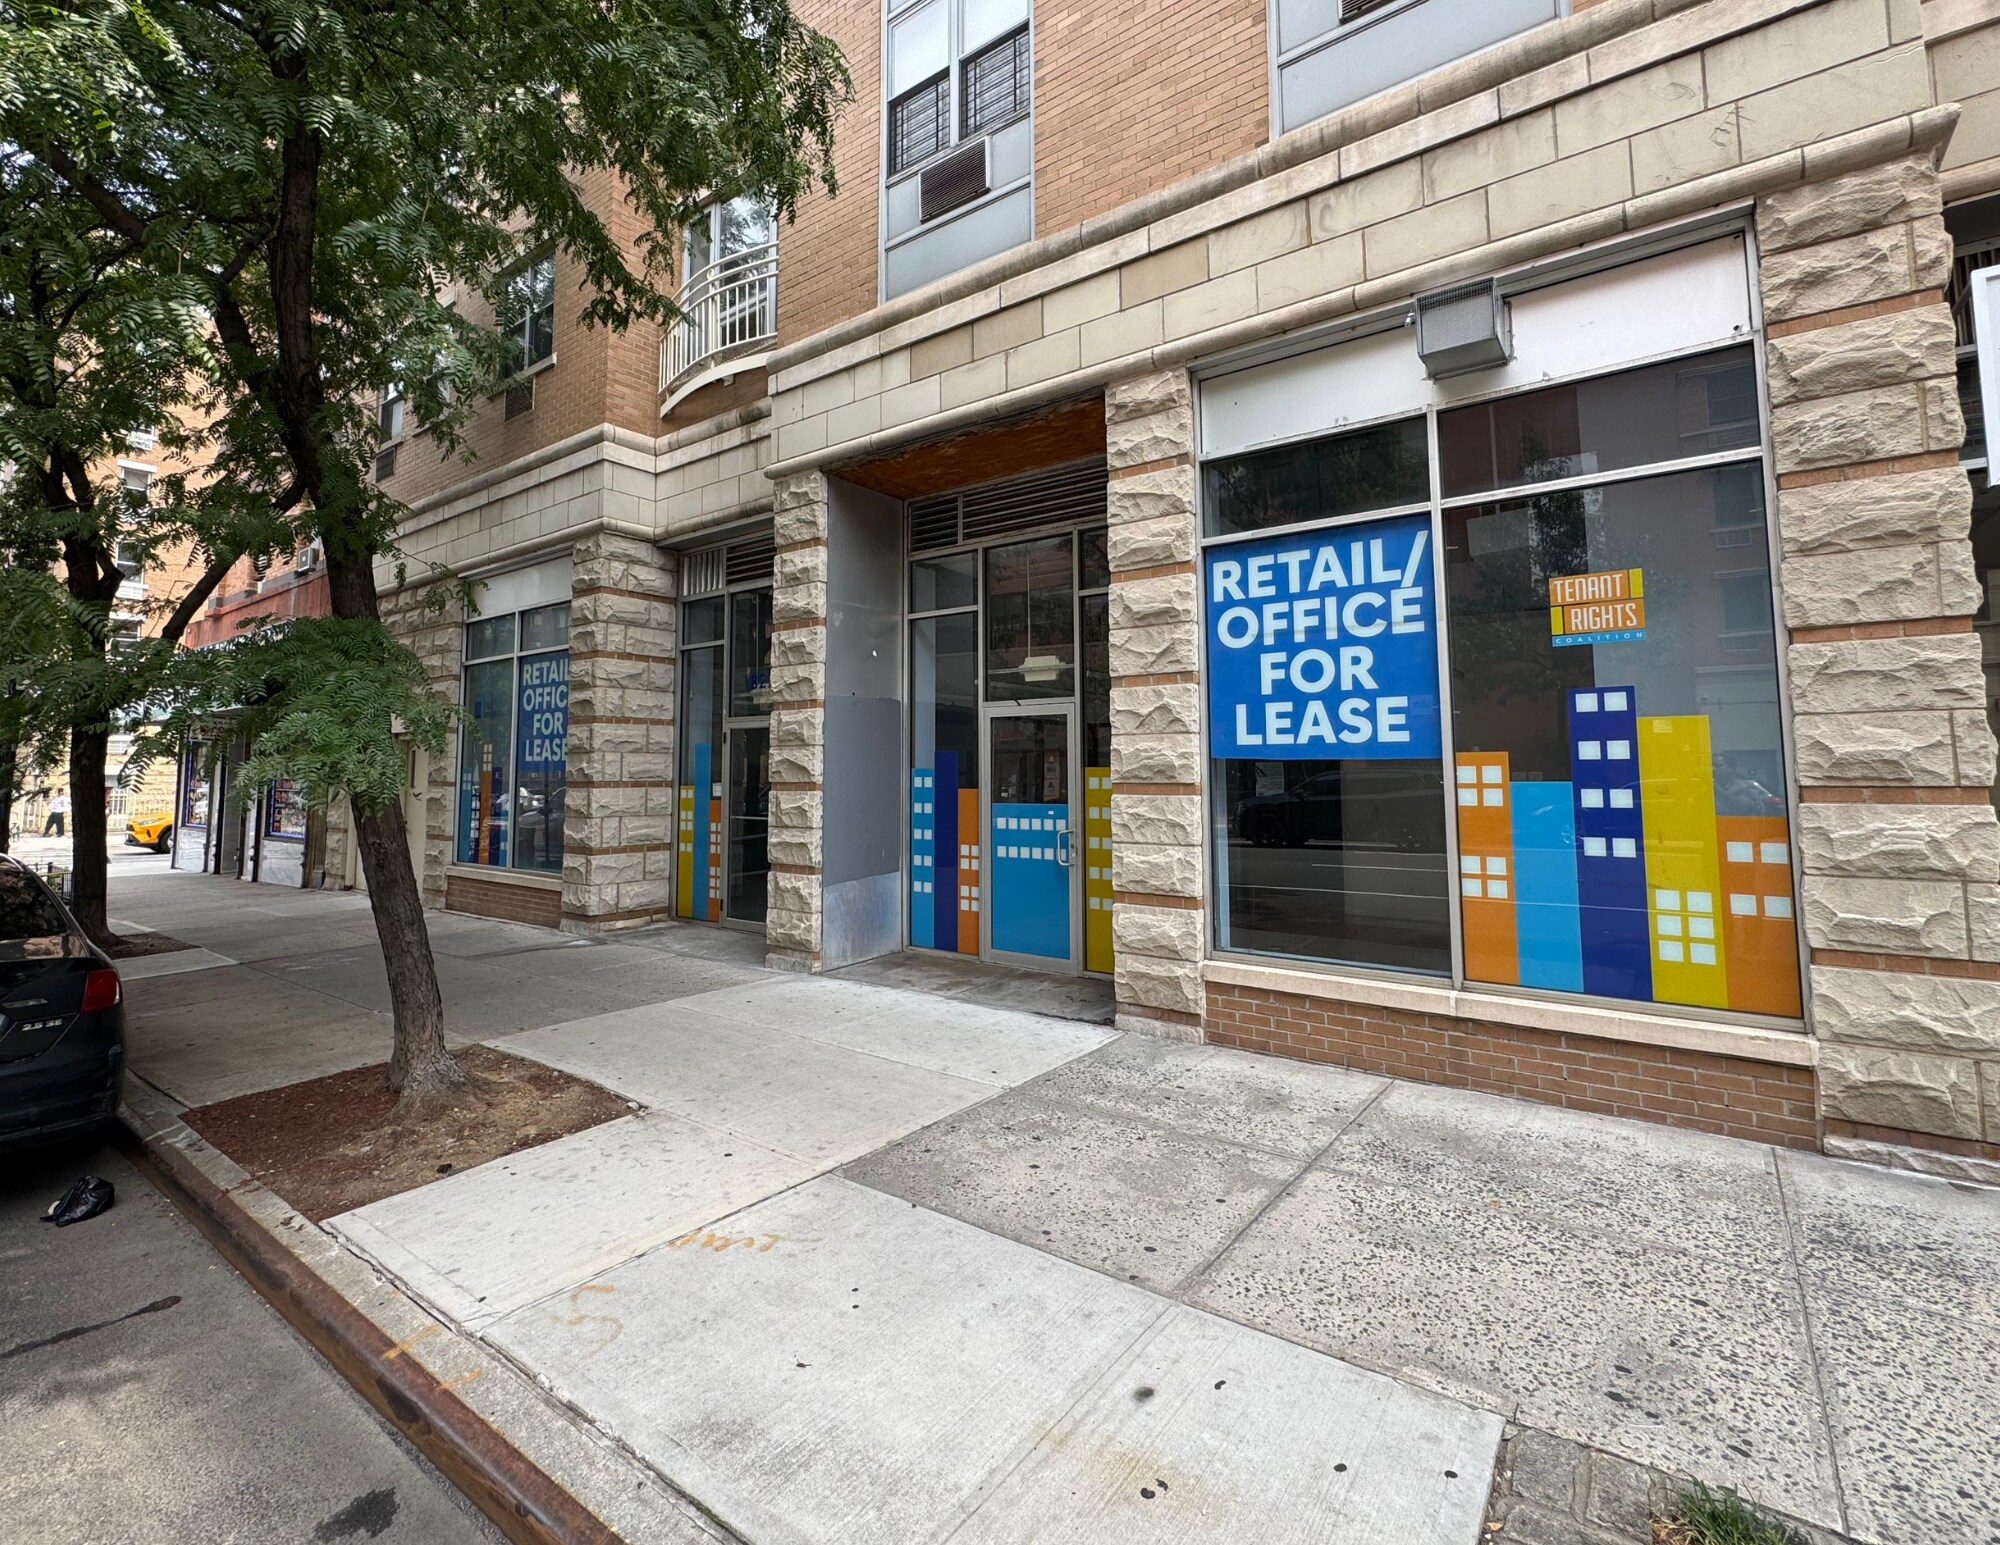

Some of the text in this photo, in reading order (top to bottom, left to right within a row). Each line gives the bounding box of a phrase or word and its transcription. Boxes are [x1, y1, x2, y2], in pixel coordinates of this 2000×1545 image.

[1213, 530, 1429, 602] RETAIL/
[1554, 574, 1622, 603] TENANT
[1217, 587, 1425, 648] OFFICE
[1571, 603, 1637, 630] RIGHTS
[1555, 632, 1643, 644] COALITION
[523, 658, 569, 686] RETAIL
[1260, 646, 1379, 695] FOR
[523, 685, 567, 711] OFFIC
[533, 712, 564, 736] FOR
[1236, 696, 1410, 745] LEASE
